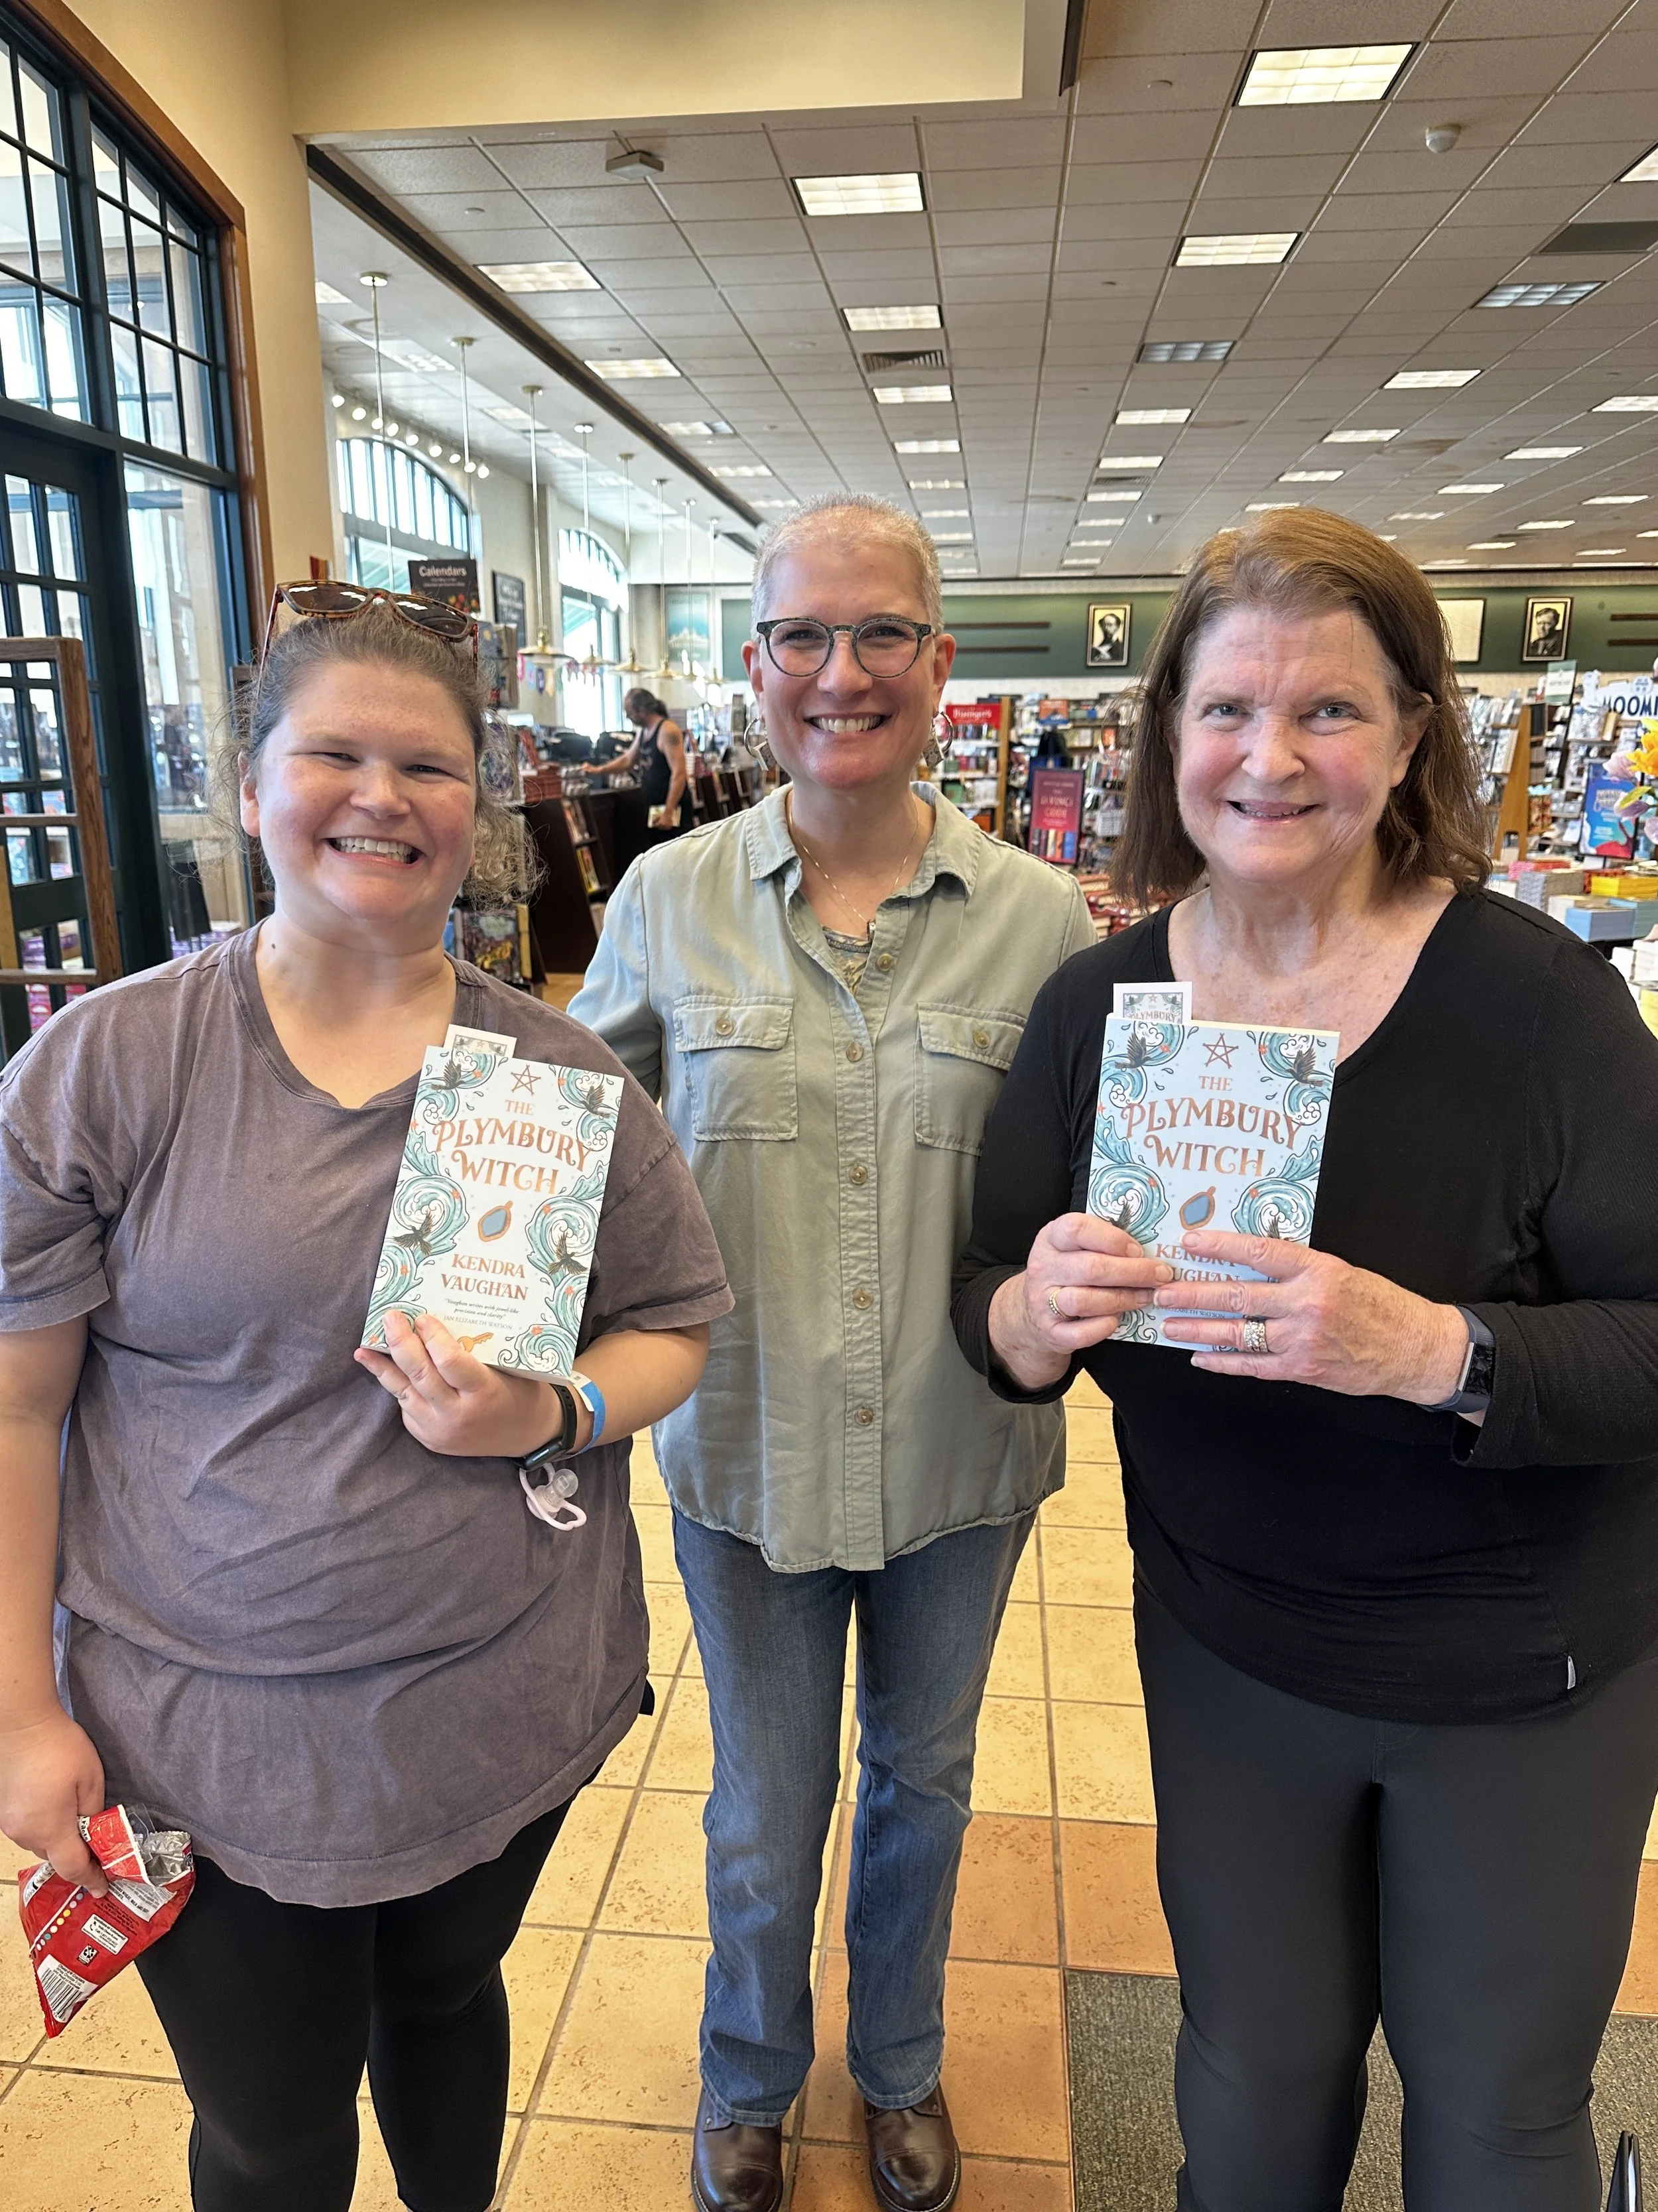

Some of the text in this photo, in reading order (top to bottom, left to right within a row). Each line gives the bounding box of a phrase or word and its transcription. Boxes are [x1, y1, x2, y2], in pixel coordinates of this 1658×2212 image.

[418, 565, 467, 577] Calendars
[1198, 1075, 1233, 1091] THE
[505, 1099, 535, 1115] THE
[1120, 1097, 1305, 1150] PLYMBURY
[432, 1118, 593, 1172] PLYMBURY
[1143, 1134, 1265, 1177] WITCH
[451, 1150, 559, 1194] WITCH
[451, 1253, 525, 1278] KENDRA
[1155, 1243, 1236, 1267] KEN
[441, 1274, 529, 1300] VAUGHAN
[456, 1317, 487, 1326] ELIZABETH
[1199, 1310, 1226, 1319] WATSON
